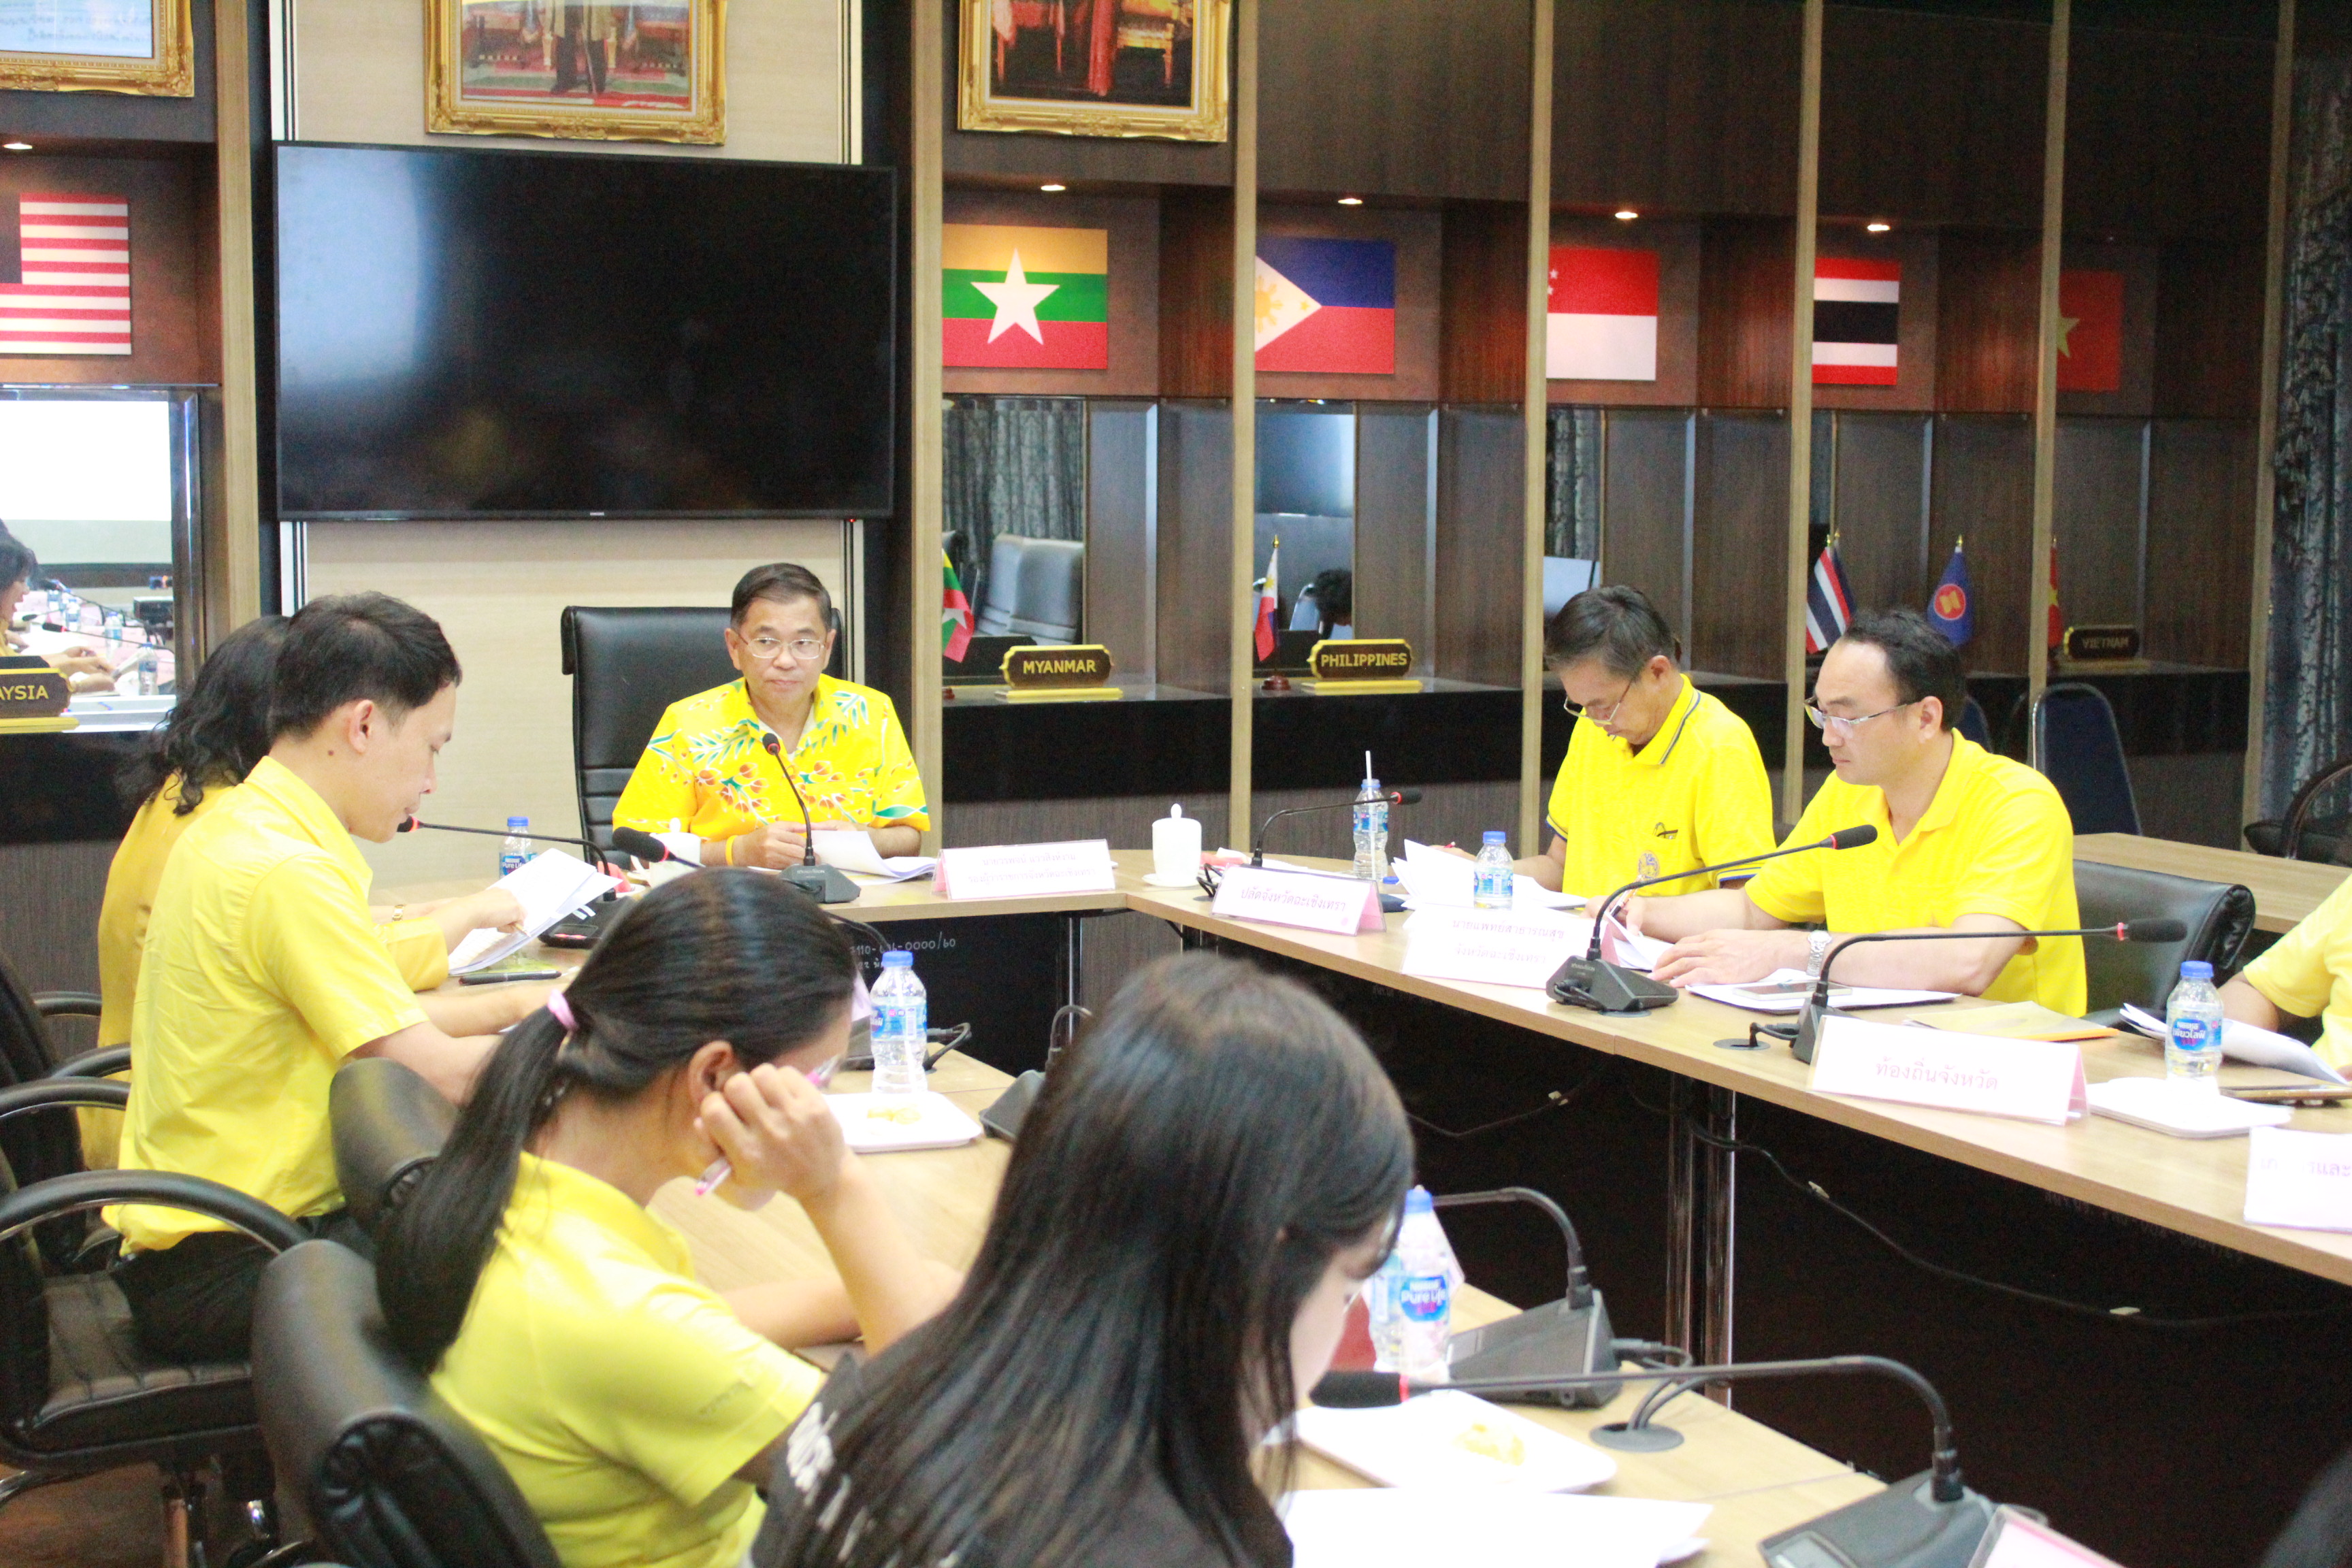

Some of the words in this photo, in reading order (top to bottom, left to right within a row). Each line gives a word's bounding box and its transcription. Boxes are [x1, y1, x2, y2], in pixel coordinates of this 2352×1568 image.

[1023, 659, 1096, 674] MYANMAR
[1321, 653, 1407, 667] PHILIPPINES
[1241, 886, 1346, 913] ปลัดจังหวัดฉะเชิงเทรา
[1452, 919, 1565, 943] นายแพทย์สาธารณสุข
[1455, 943, 1546, 964] จังหวัดฉะเชิงเทรา
[1876, 1056, 1998, 1090] ท้องถิ่นจังหวัด
[1401, 1290, 1430, 1304] Pure
